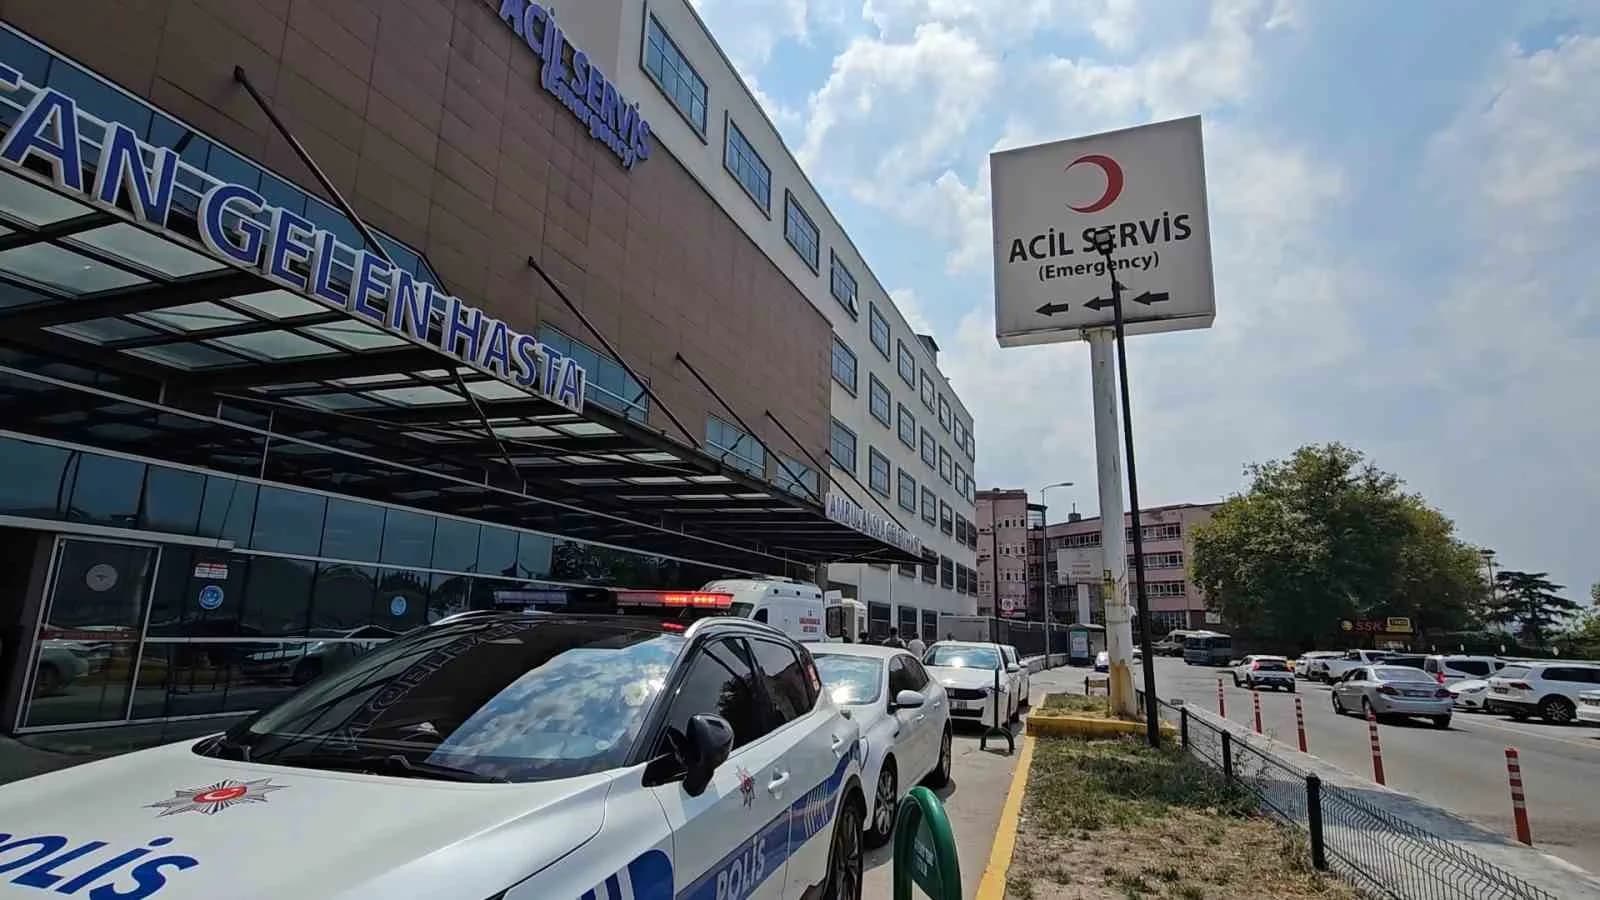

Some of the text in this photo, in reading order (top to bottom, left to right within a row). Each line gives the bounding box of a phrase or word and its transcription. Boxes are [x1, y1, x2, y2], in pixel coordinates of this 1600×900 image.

[571, 48, 651, 160] SERVİS
[0, 62, 586, 415] AN GELEN HASTA
[1008, 228, 1074, 264] ACİL
[1039, 251, 1159, 281] (Emergency)
[0, 833, 199, 900] OLİS
[716, 834, 766, 900] POLİS
